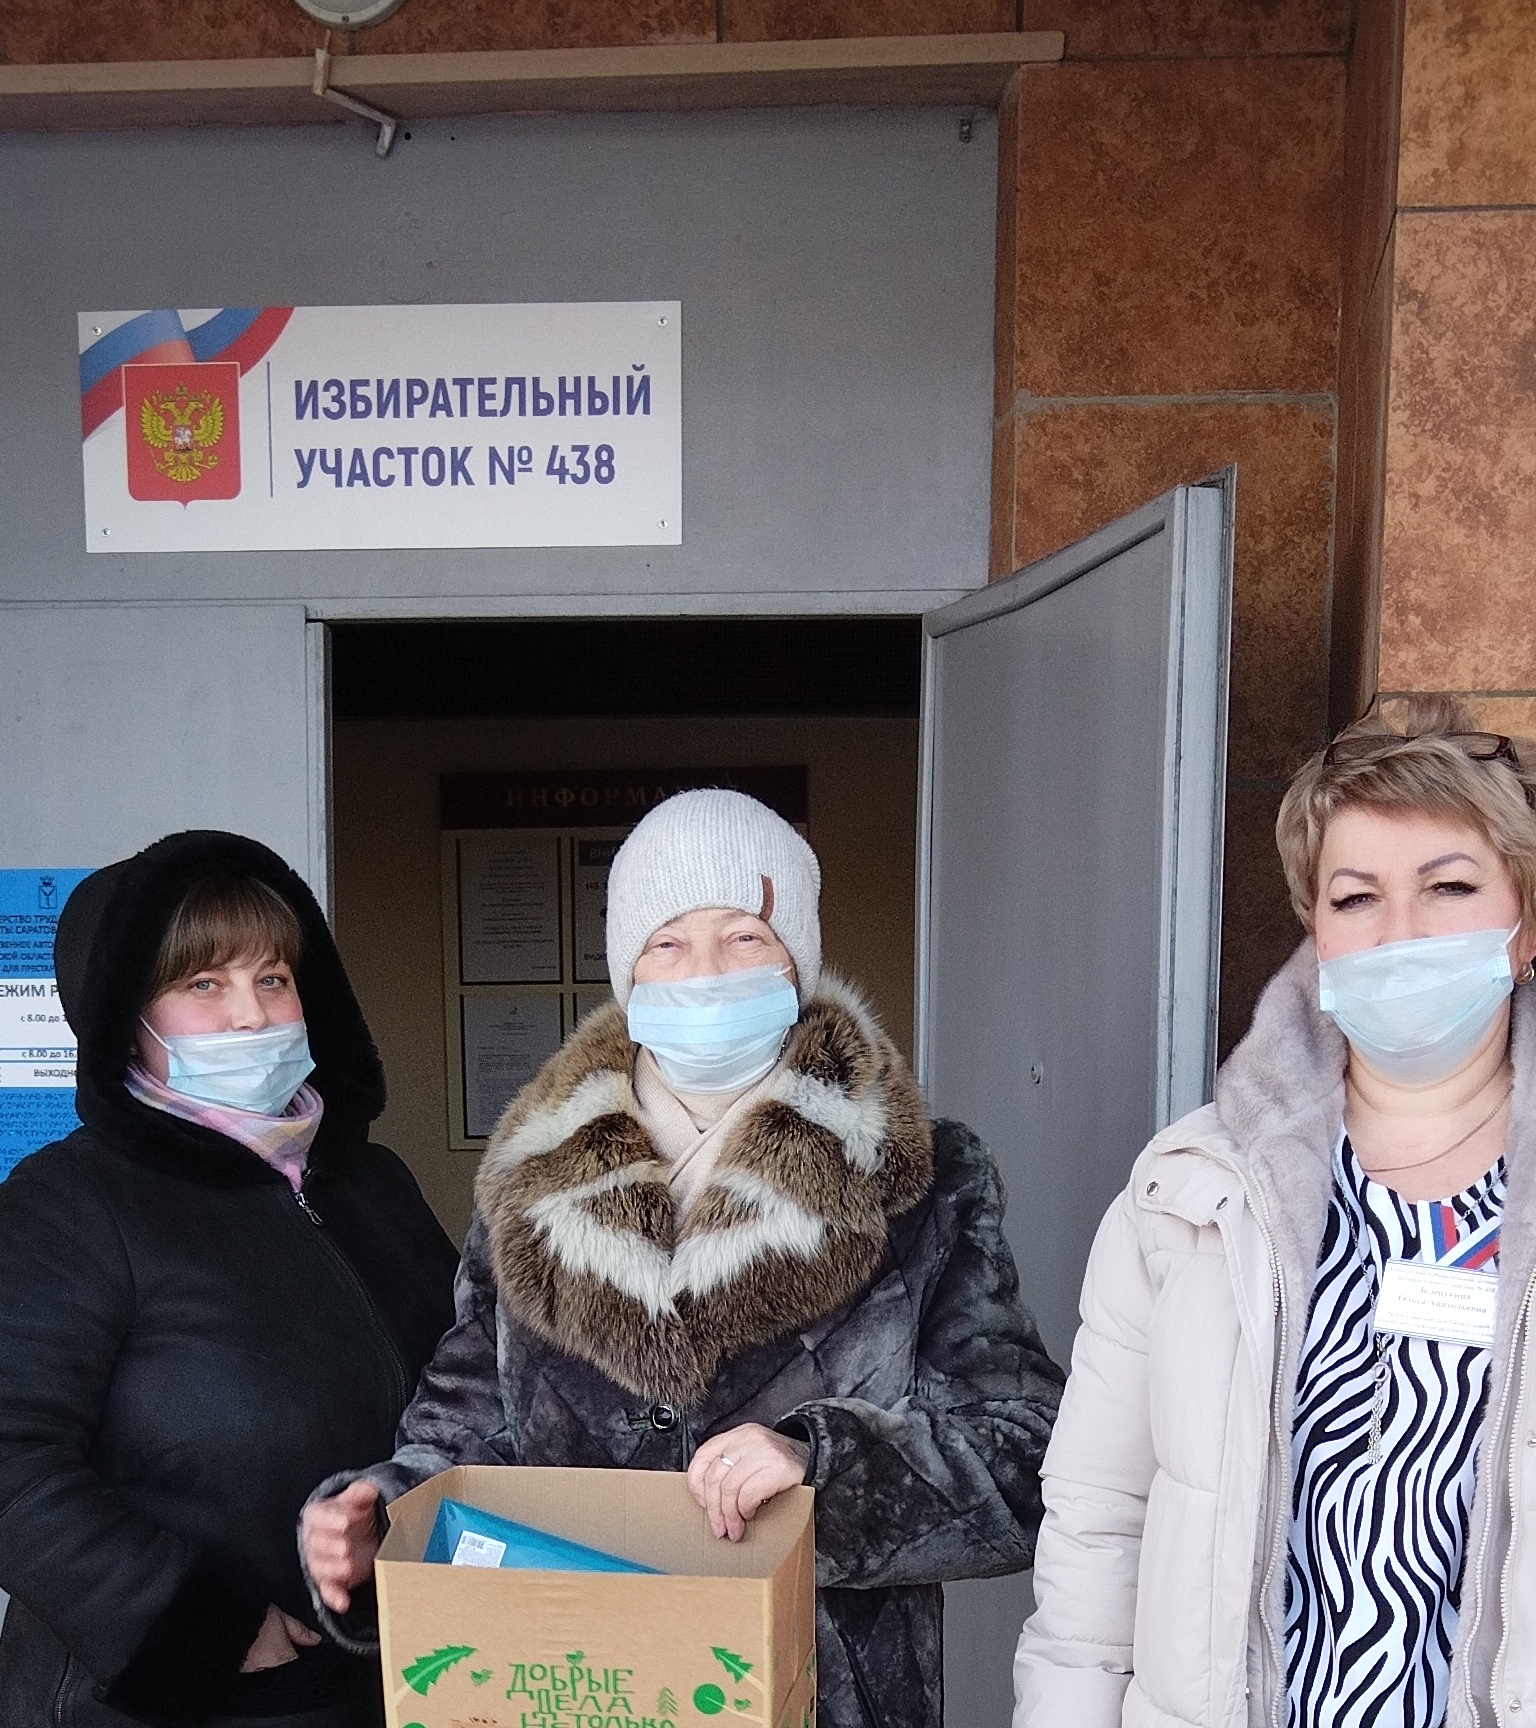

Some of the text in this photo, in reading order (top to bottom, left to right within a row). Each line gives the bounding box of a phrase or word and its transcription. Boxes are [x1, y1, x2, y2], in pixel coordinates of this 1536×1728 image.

[294, 363, 652, 421] ИЗБИРАТЕЛЬНЫЙ
[295, 444, 616, 488] УЧАСТОК № 438
[27, 1014, 46, 1022] 8.00
[28, 1050, 47, 1058] 8.00
[506, 1664, 635, 1700] ДОБРЫЕ
[532, 1689, 634, 1720] ДЕЛА
